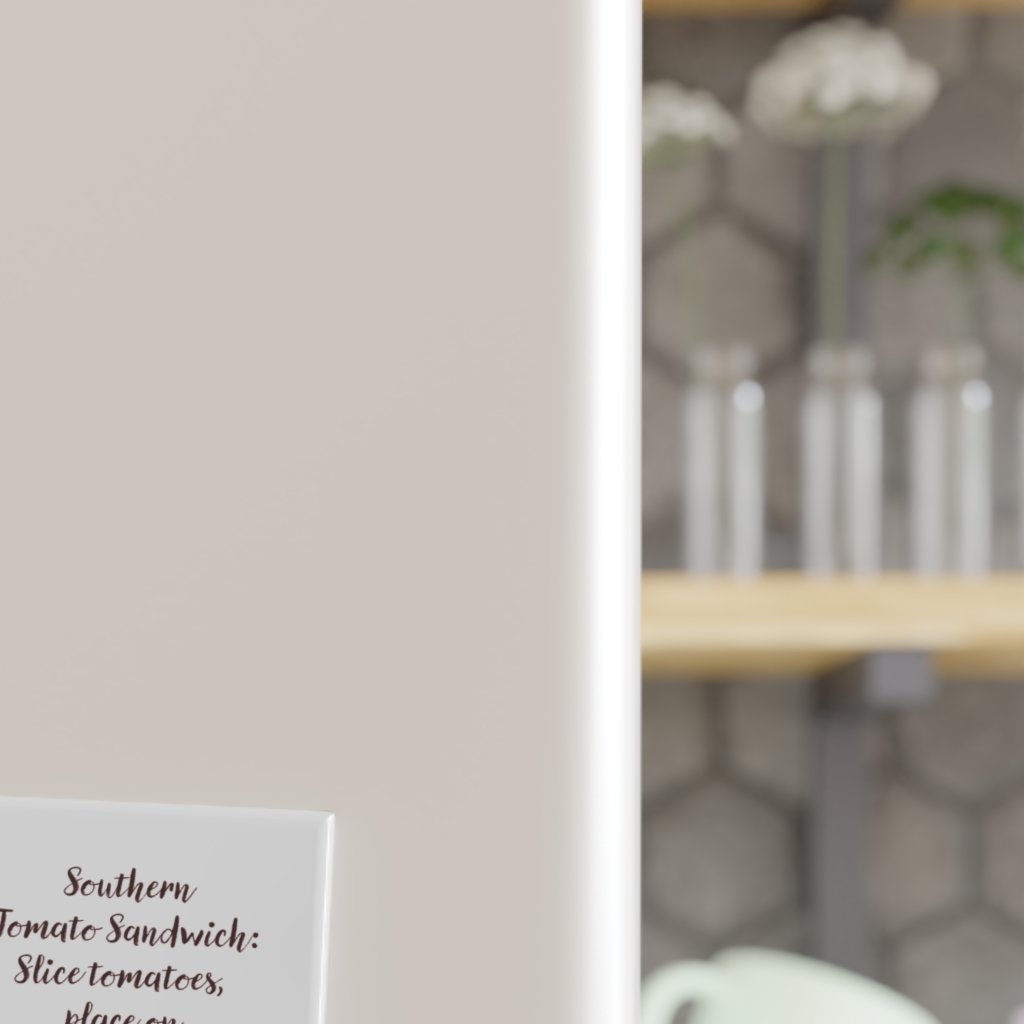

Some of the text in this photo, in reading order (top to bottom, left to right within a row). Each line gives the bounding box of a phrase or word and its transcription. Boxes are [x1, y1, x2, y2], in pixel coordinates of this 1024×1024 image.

[63, 866, 198, 904] Southern
[105, 913, 260, 953] Sandwich:
[13, 953, 224, 997] Slice tomatoes,
